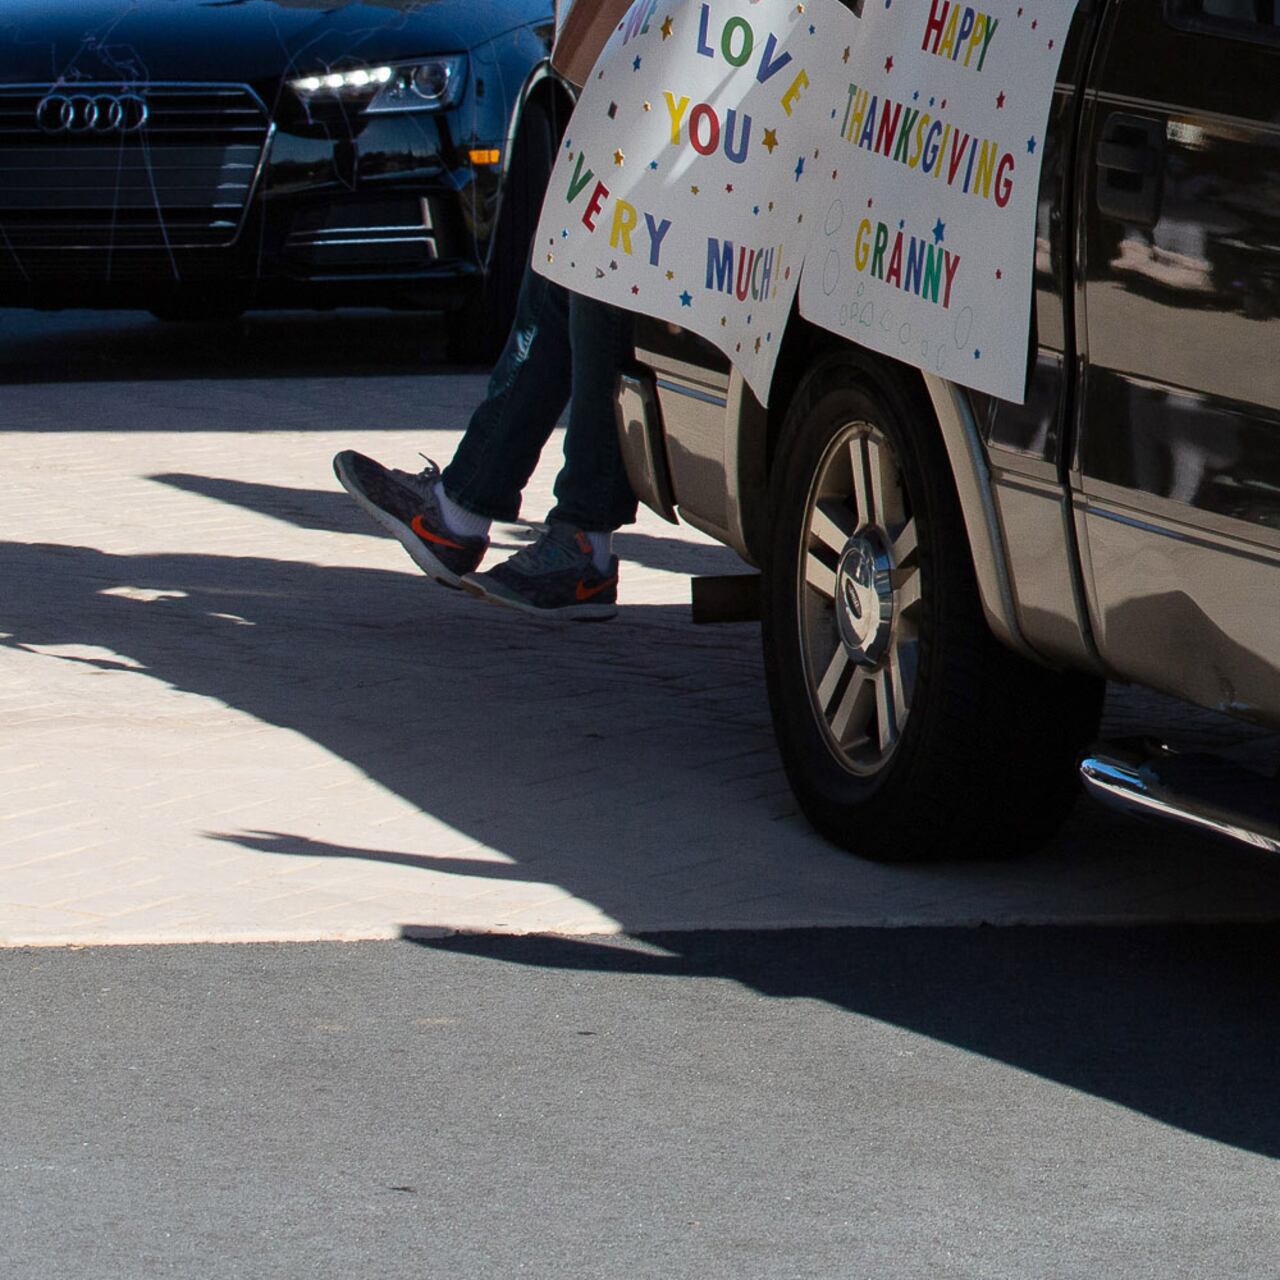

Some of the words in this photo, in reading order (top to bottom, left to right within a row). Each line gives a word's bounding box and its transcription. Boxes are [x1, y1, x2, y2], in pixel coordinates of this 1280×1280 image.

[696, 2, 811, 117] LOVE
[662, 89, 753, 164] YOU
[839, 82, 1015, 209] THANKSGIVING
[565, 151, 672, 268] VERY
[705, 236, 783, 303] MUCH!
[854, 217, 961, 310] GRANNY
